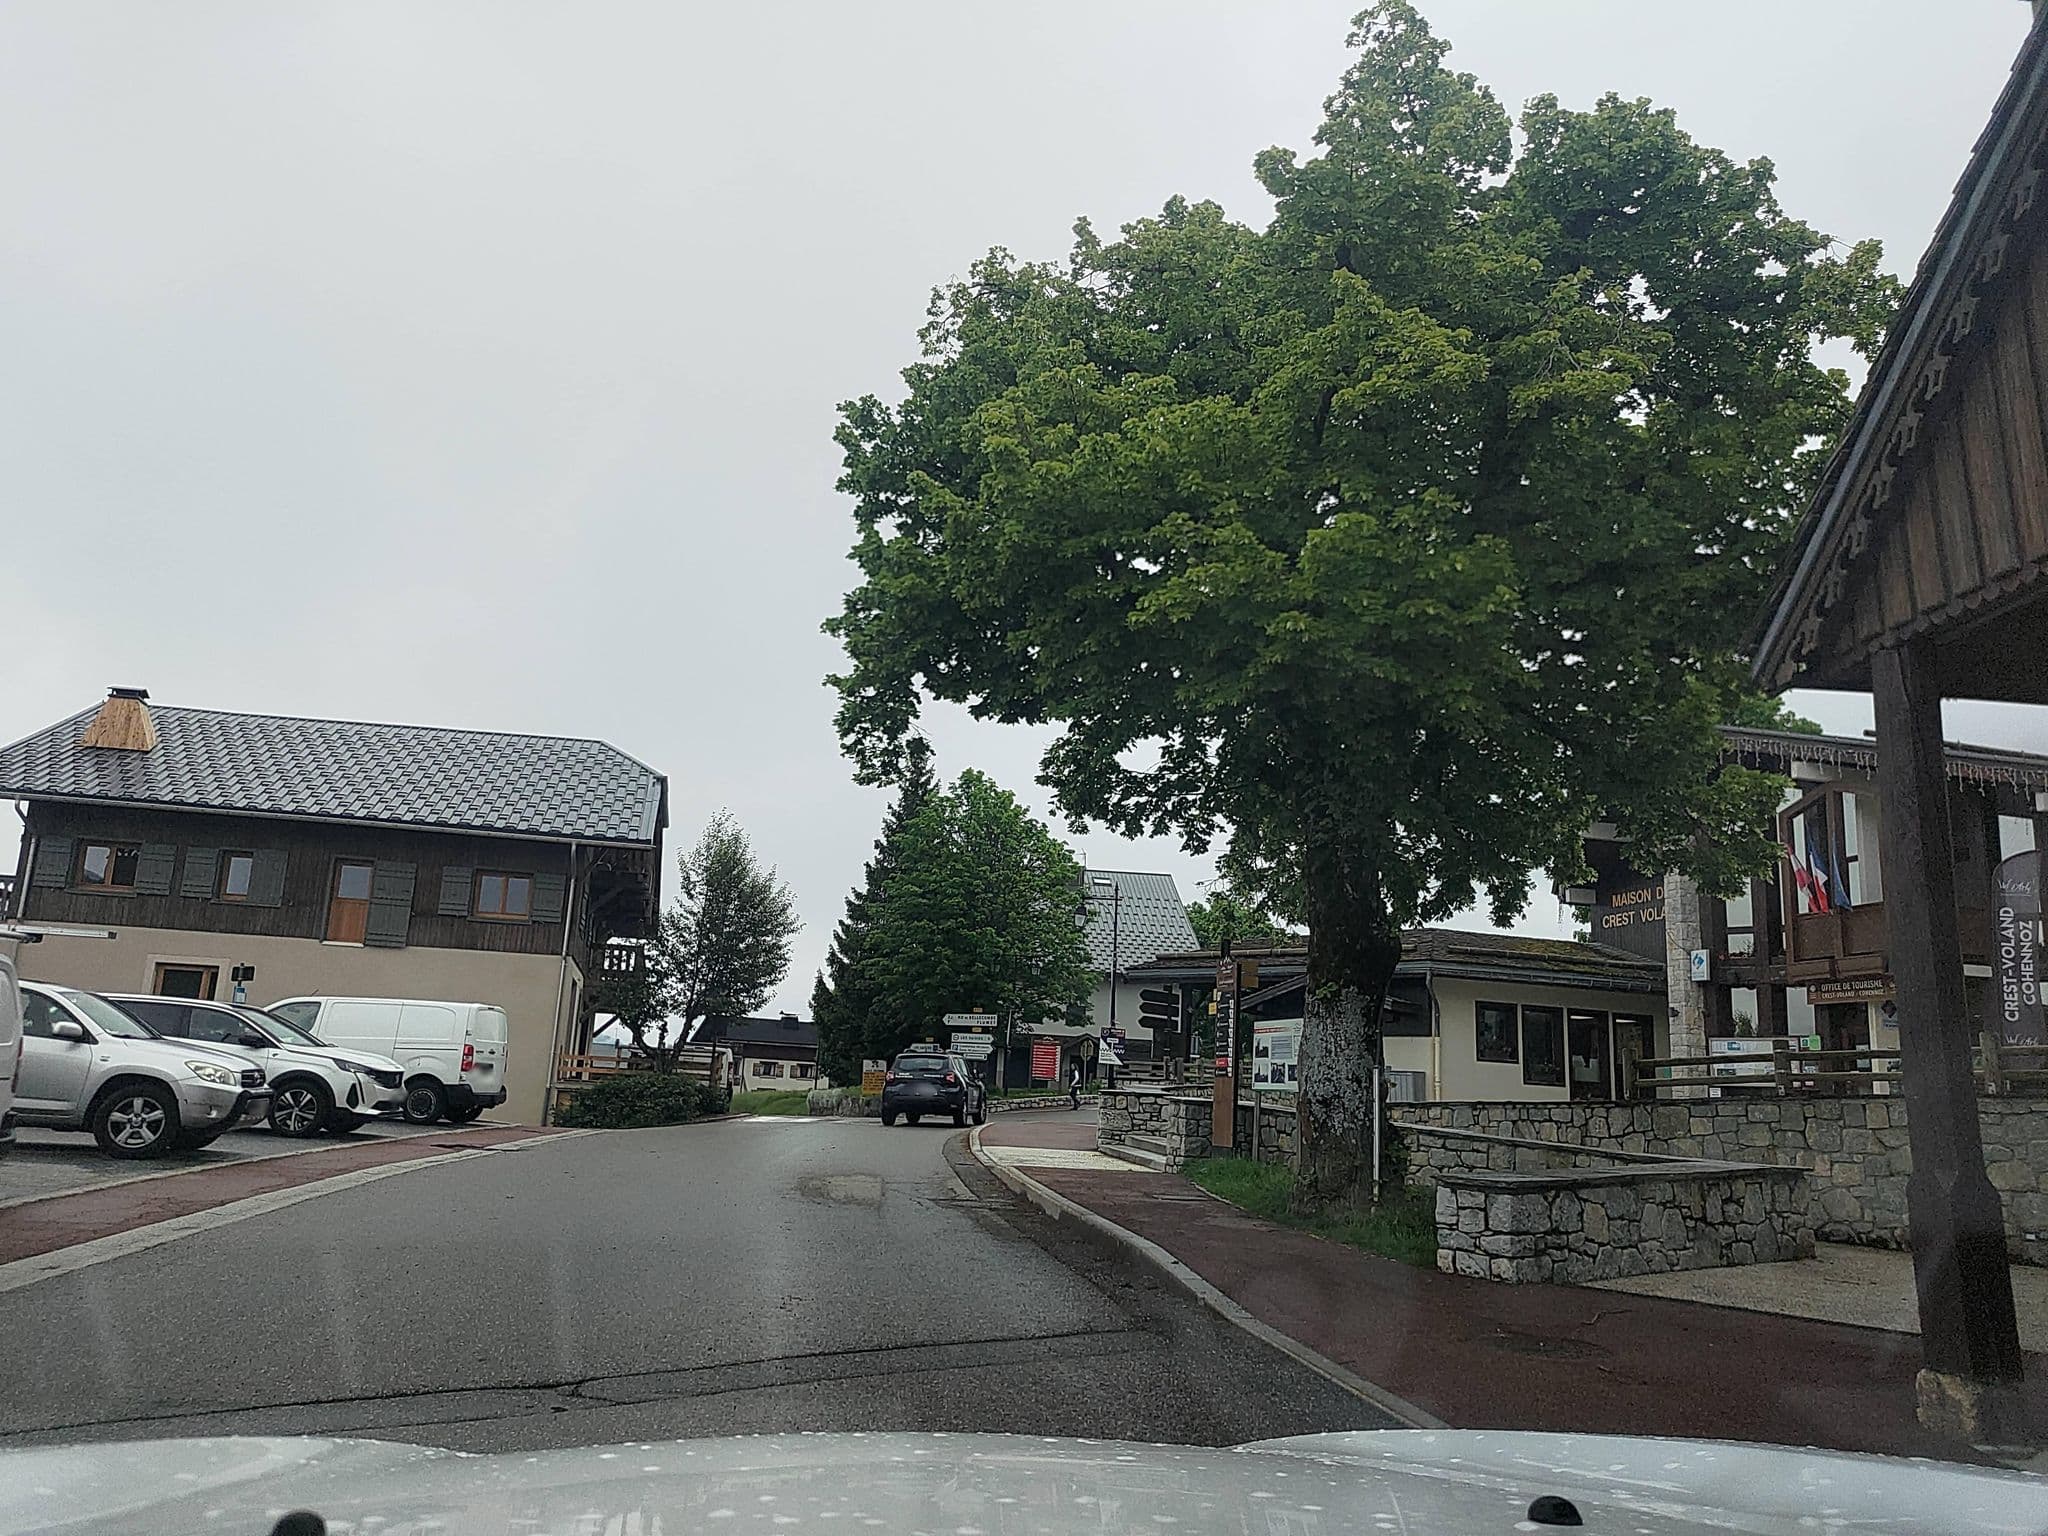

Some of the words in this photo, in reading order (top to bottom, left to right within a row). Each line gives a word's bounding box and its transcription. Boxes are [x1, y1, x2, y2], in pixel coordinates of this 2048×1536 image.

[1612, 888, 1652, 908] MAISON
[1656, 886, 1664, 900] D
[1602, 911, 1635, 929] CREST
[1640, 906, 1666, 923] VOLA
[2000, 906, 2019, 1022] CREST-VOLAND
[2019, 920, 2036, 1006] COHENNOZ
[1821, 983, 1842, 992] OFFICE
[1842, 982, 1851, 990] DE
[1852, 979, 1883, 990] TOURISME
